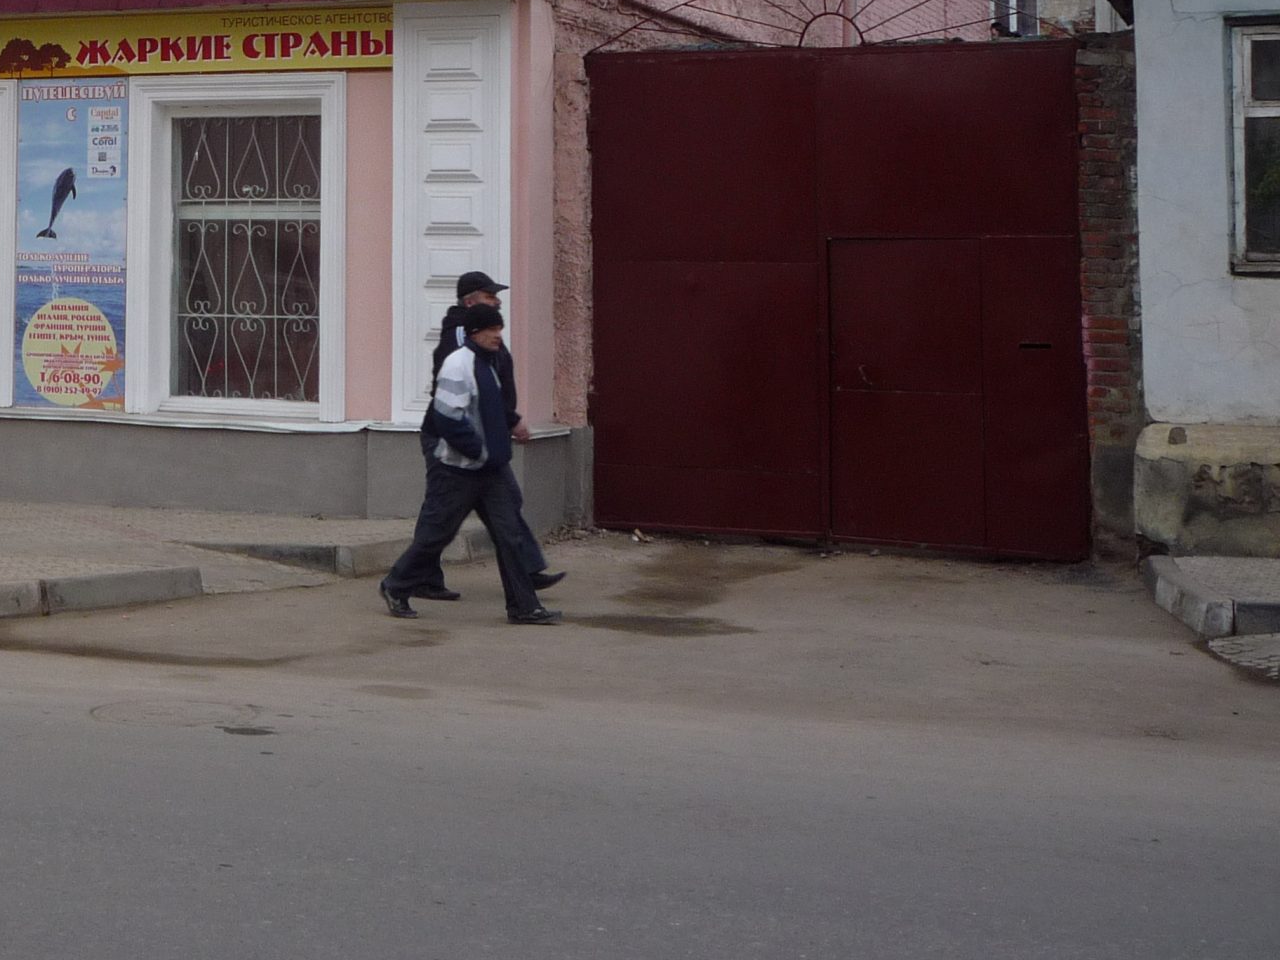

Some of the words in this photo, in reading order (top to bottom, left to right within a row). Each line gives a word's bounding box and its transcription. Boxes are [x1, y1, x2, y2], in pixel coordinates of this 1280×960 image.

[221, 14, 321, 27] ТУРИСТИЧЕСКОЕ
[325, 12, 393, 25] АГЕНТСТВО
[76, 35, 231, 64] ЖАРКИЕ
[242, 30, 393, 59] СТРАНЫ
[23, 82, 126, 102] ПУТЕШЕСТВУЙ
[92, 137, 117, 146] Coral
[53, 264, 121, 273] ТУРОПЕРАТОРЫ
[18, 275, 51, 283] ТОЛЬКО
